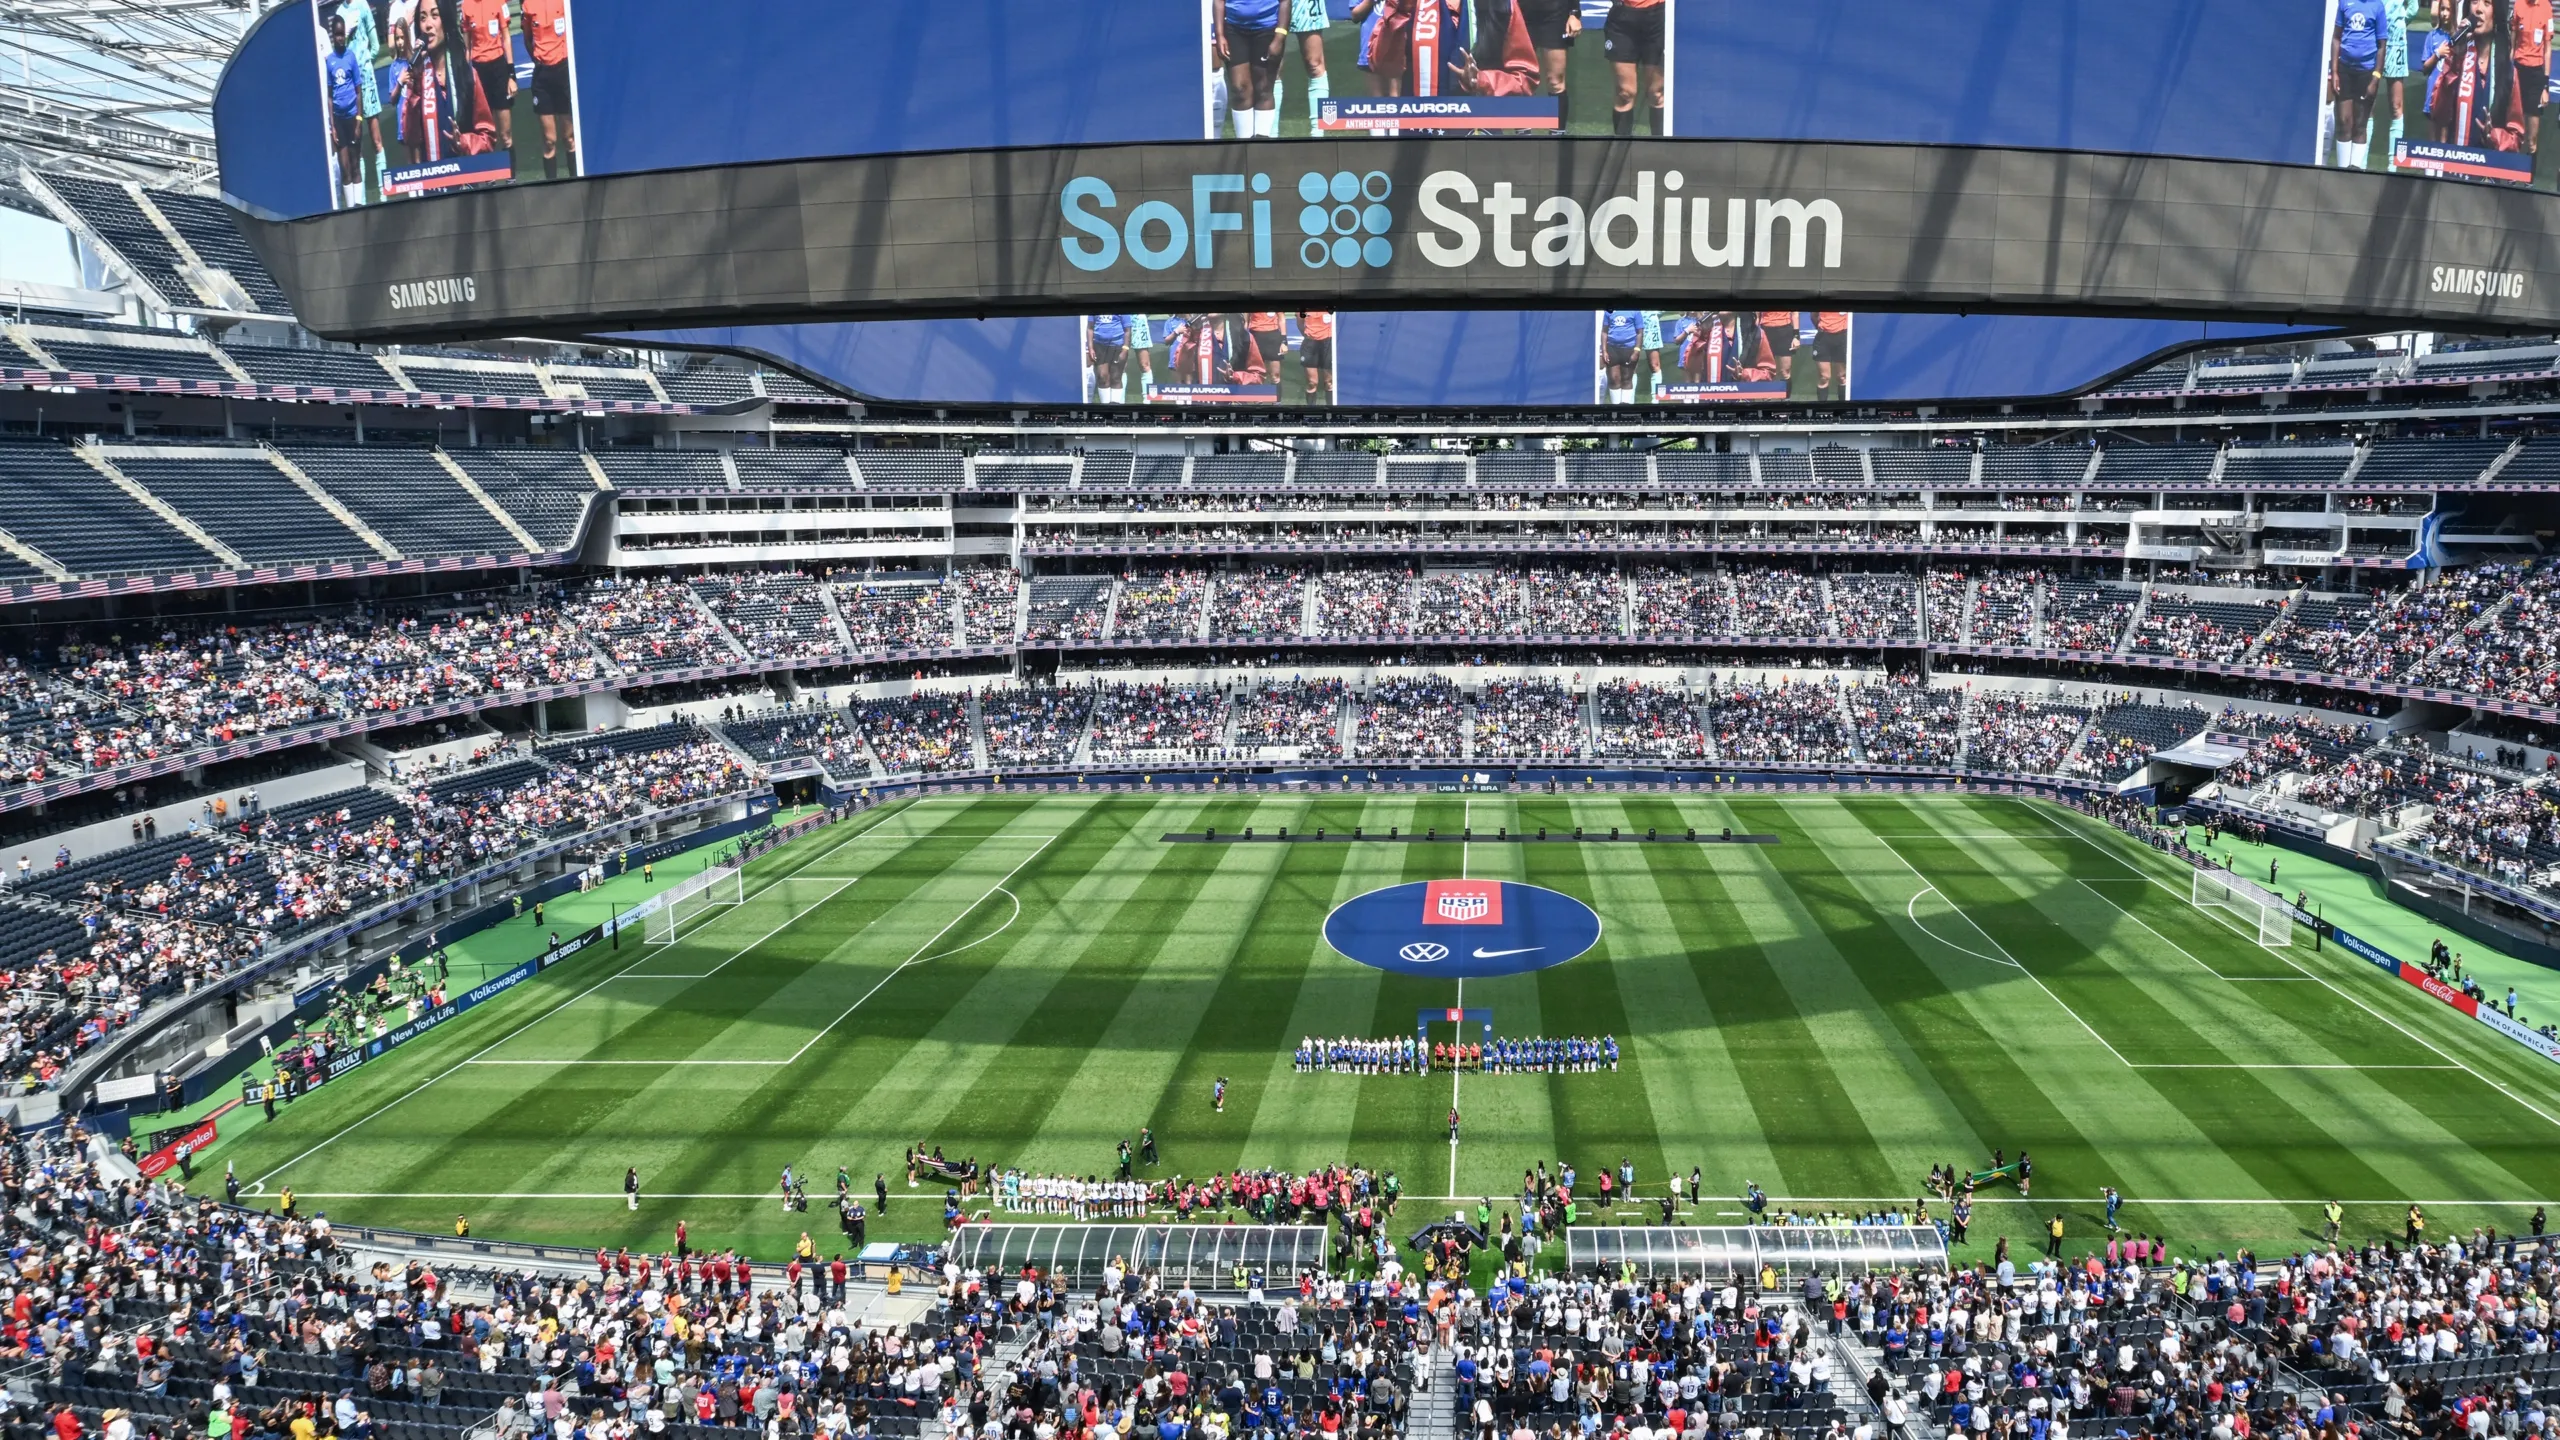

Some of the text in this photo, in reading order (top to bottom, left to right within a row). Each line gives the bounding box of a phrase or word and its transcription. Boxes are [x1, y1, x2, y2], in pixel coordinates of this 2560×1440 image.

[1344, 103, 1471, 114] JULES AURORA
[1345, 119, 1399, 128] ANTHEM SINGER
[2411, 146, 2486, 163] JULES AURORA
[394, 169, 421, 181] JULES
[422, 163, 460, 177] AURORA
[1061, 170, 1843, 271] SoFi Stadium
[2431, 266, 2524, 298] SAMSUNG
[389, 277, 476, 309] SAMSUNG
[1442, 898, 1484, 906] USA
[544, 939, 581, 966] NIKE SOCCER
[2343, 933, 2391, 967] Volkswagen
[470, 968, 527, 1002] Volkswagen
[391, 1006, 455, 1044] New York Life
[2482, 1012, 2545, 1050] BANK OF AMERICA
[328, 1049, 360, 1074] TRULY
[1359, 1287, 1365, 1296] 11
[1078, 1316, 1087, 1325] 14
[802, 1371, 810, 1379] 13
[1666, 1389, 1673, 1398] 15
[1687, 1385, 1694, 1393] 17
[1793, 1390, 1800, 1398] 17
[1267, 1395, 1277, 1406] 13
